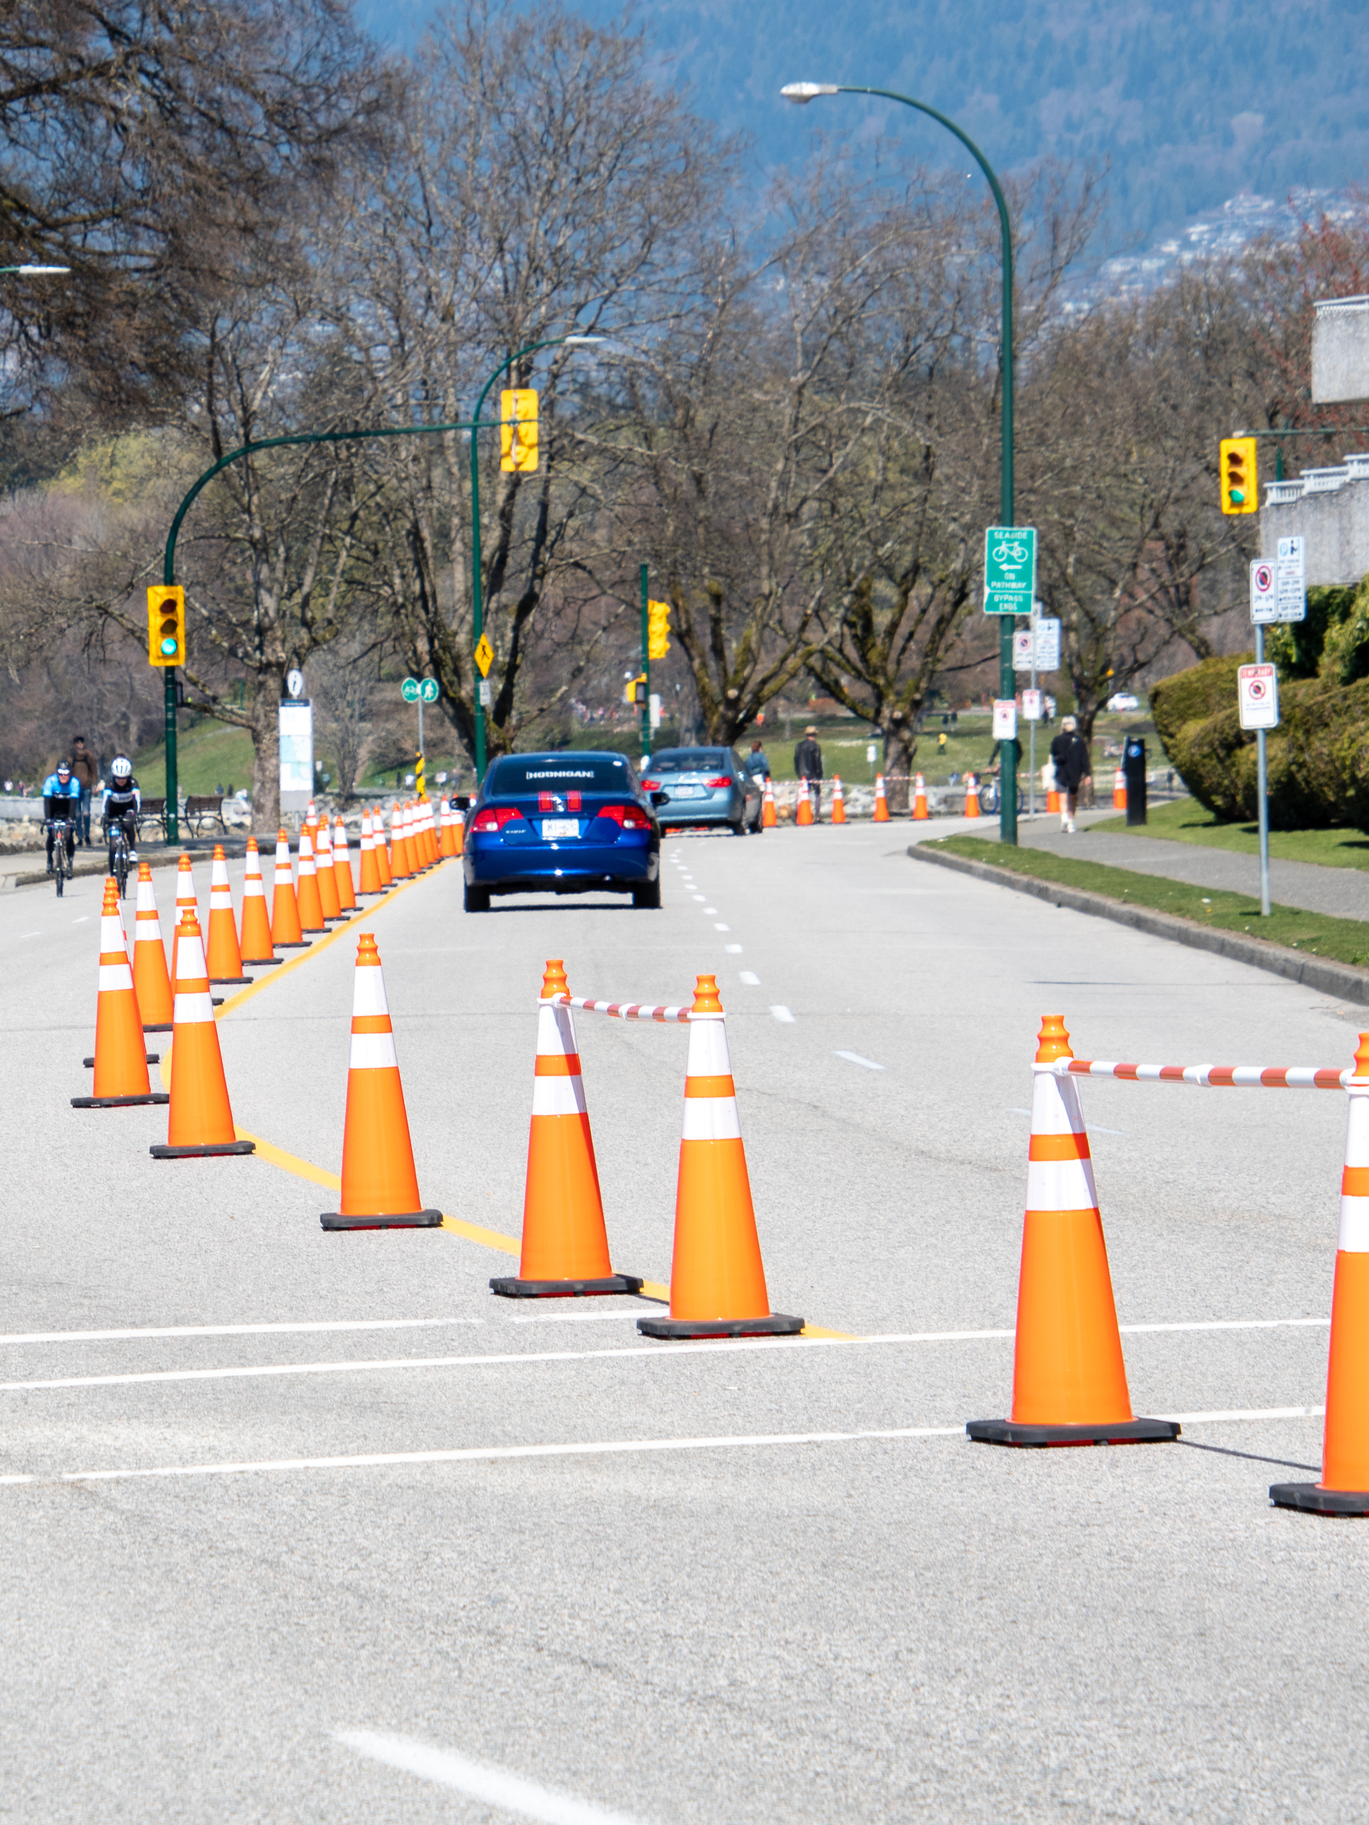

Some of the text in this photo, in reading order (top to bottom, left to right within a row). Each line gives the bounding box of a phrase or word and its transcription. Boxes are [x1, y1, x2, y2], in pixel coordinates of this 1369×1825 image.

[994, 531, 1028, 539] SEASIDE
[1004, 572, 1016, 580] ON
[991, 581, 1027, 589] PATHWAY
[994, 594, 1024, 602] BYPASS
[999, 602, 1018, 611] ENDS
